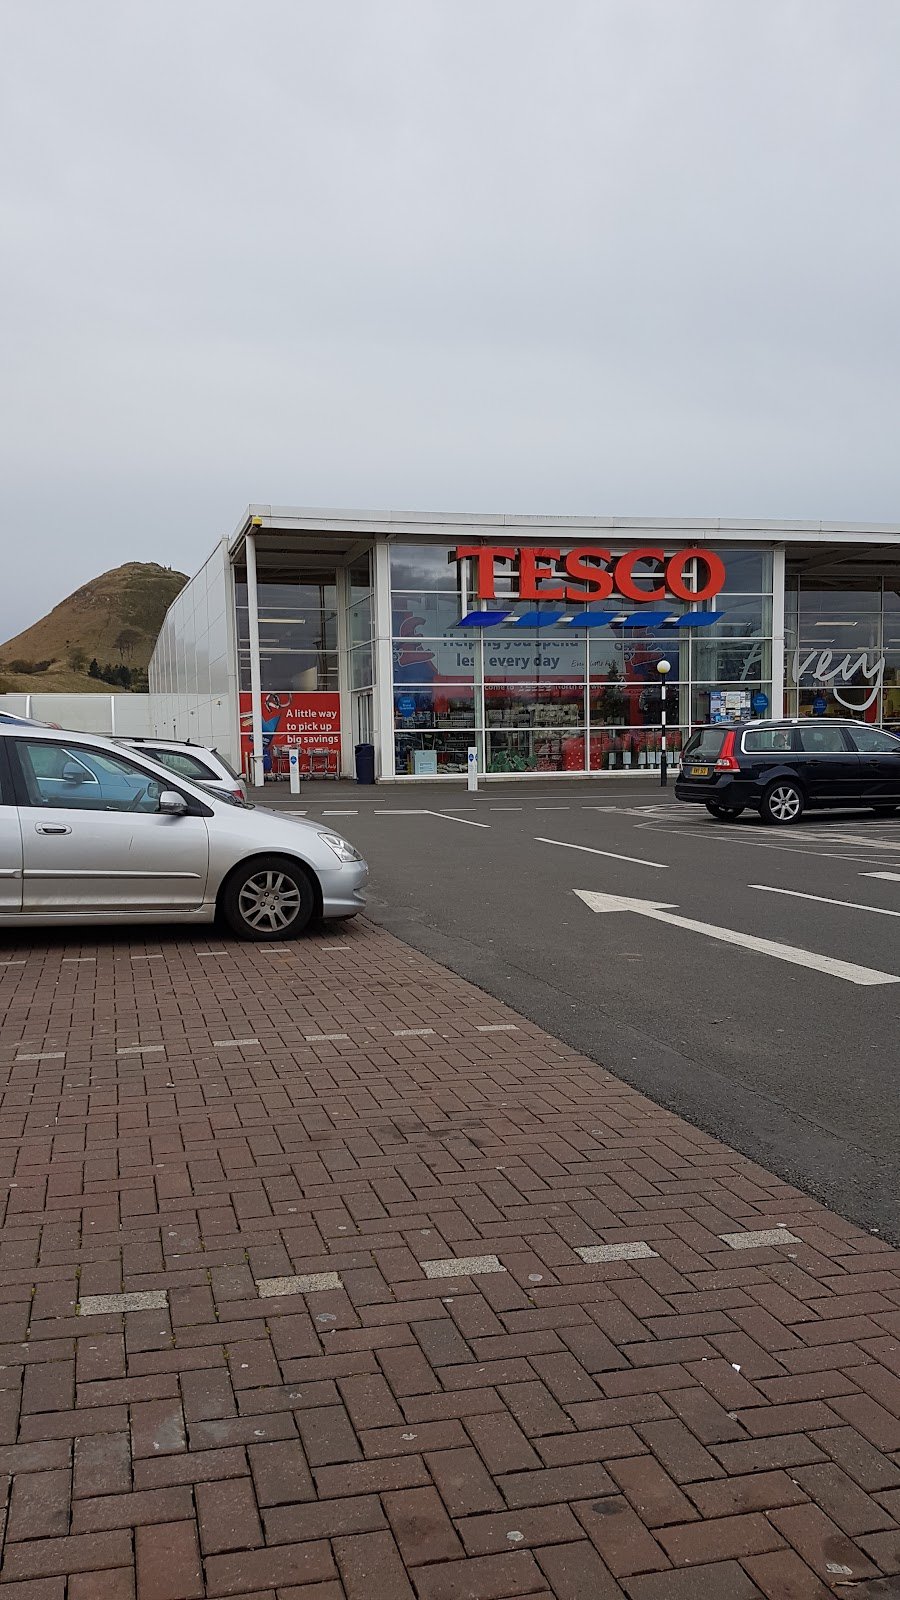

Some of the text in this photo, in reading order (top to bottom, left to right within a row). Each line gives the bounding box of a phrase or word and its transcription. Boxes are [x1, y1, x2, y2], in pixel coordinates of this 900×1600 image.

[456, 546, 726, 602] TESCO
[456, 653, 559, 669] les every day
[286, 709, 337, 719] A little way
[287, 722, 332, 732] to pick up
[287, 735, 339, 745] big savings
